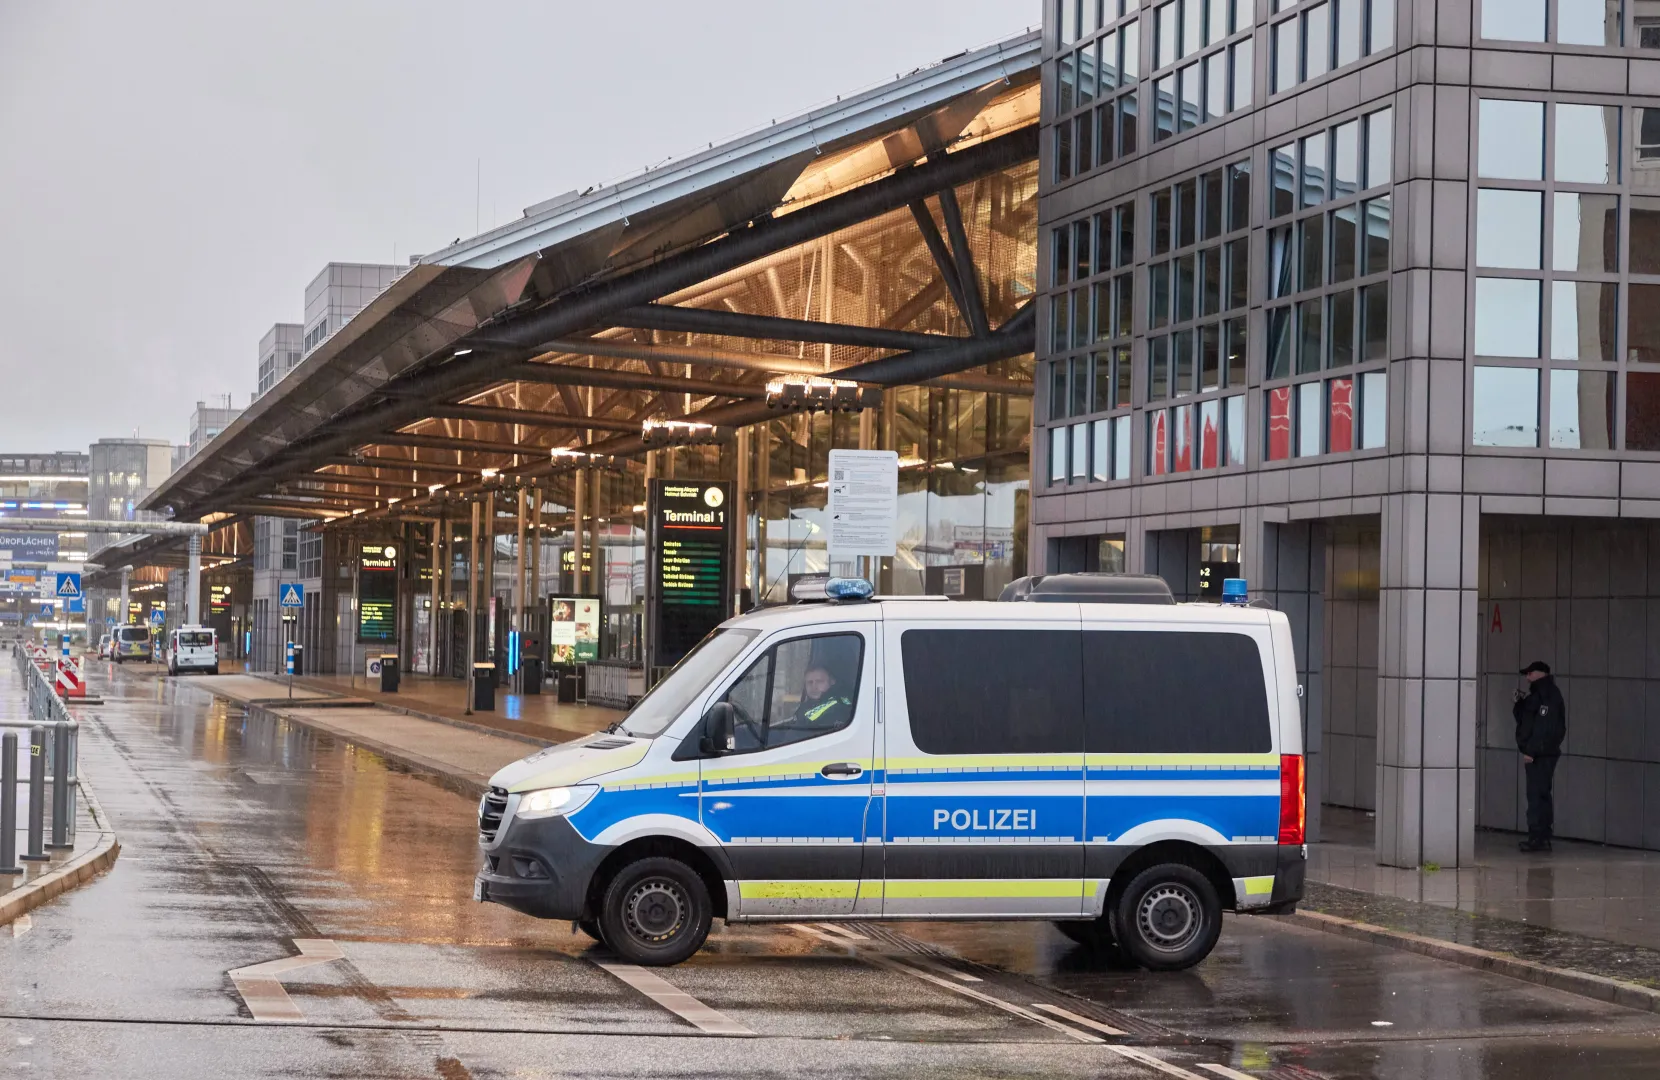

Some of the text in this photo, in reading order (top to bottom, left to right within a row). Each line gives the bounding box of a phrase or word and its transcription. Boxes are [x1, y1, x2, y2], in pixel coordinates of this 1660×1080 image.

[663, 510, 724, 523] Terminal 1
[362, 558, 396, 567] Terminal 1
[1204, 567, 1211, 576] 2
[1491, 602, 1503, 634] A
[933, 808, 1036, 831] POLIZEI
